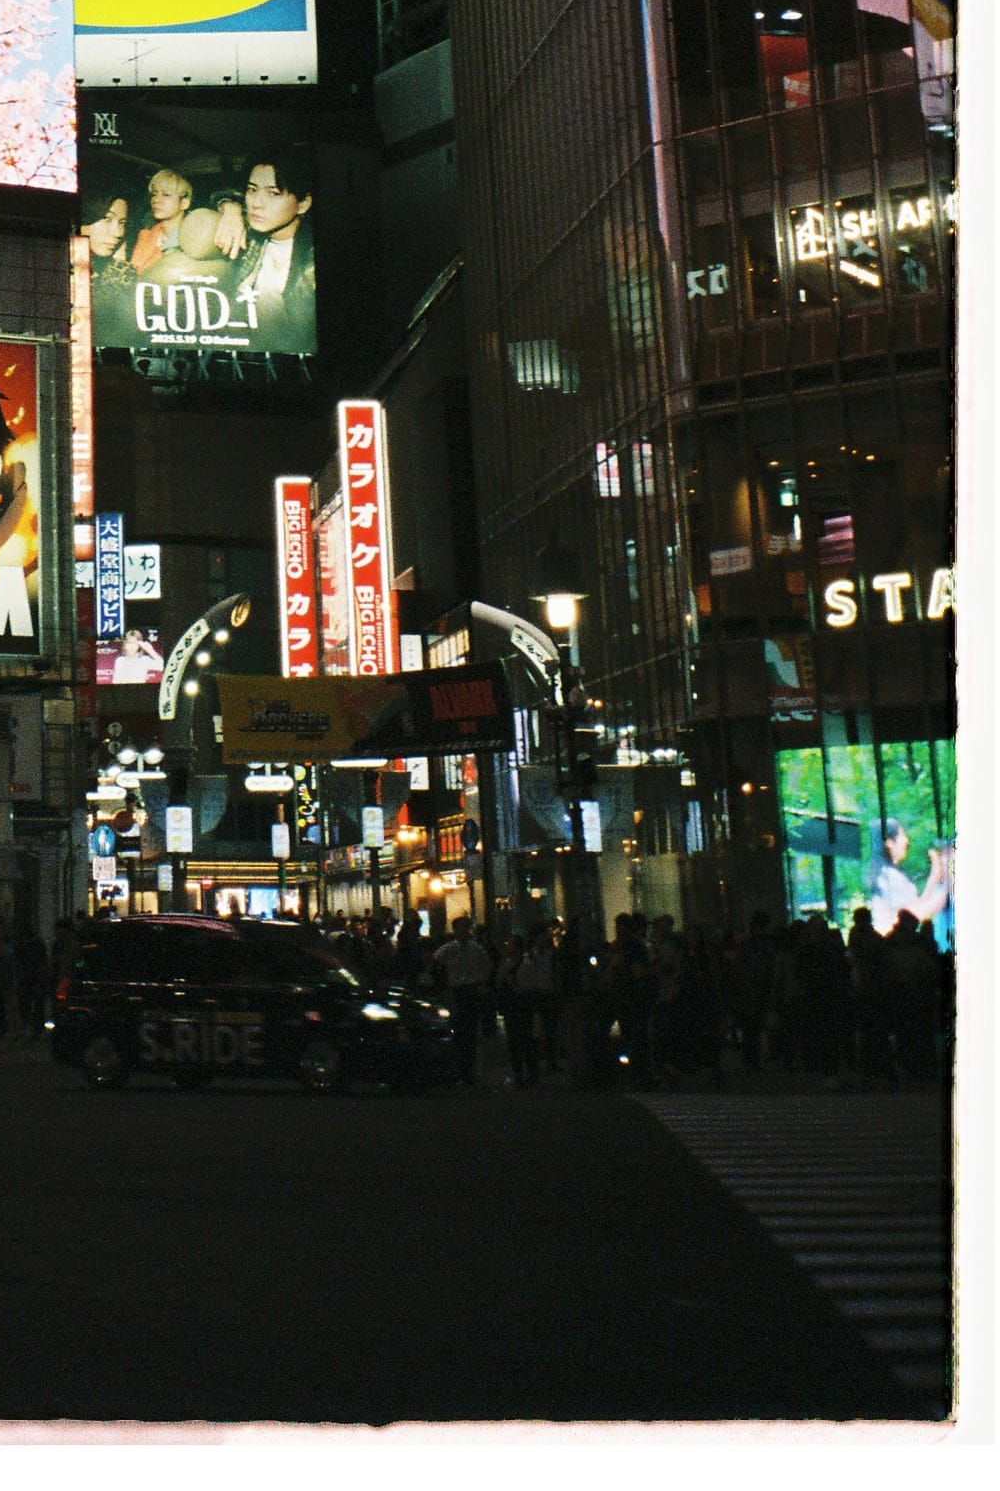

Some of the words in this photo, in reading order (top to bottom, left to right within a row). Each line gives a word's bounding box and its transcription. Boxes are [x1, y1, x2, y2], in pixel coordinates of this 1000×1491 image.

[284, 500, 301, 532] BIG
[346, 423, 380, 569] カラオケ
[286, 533, 304, 580] ECHO
[355, 585, 375, 622] BIG
[824, 566, 957, 629] STA
